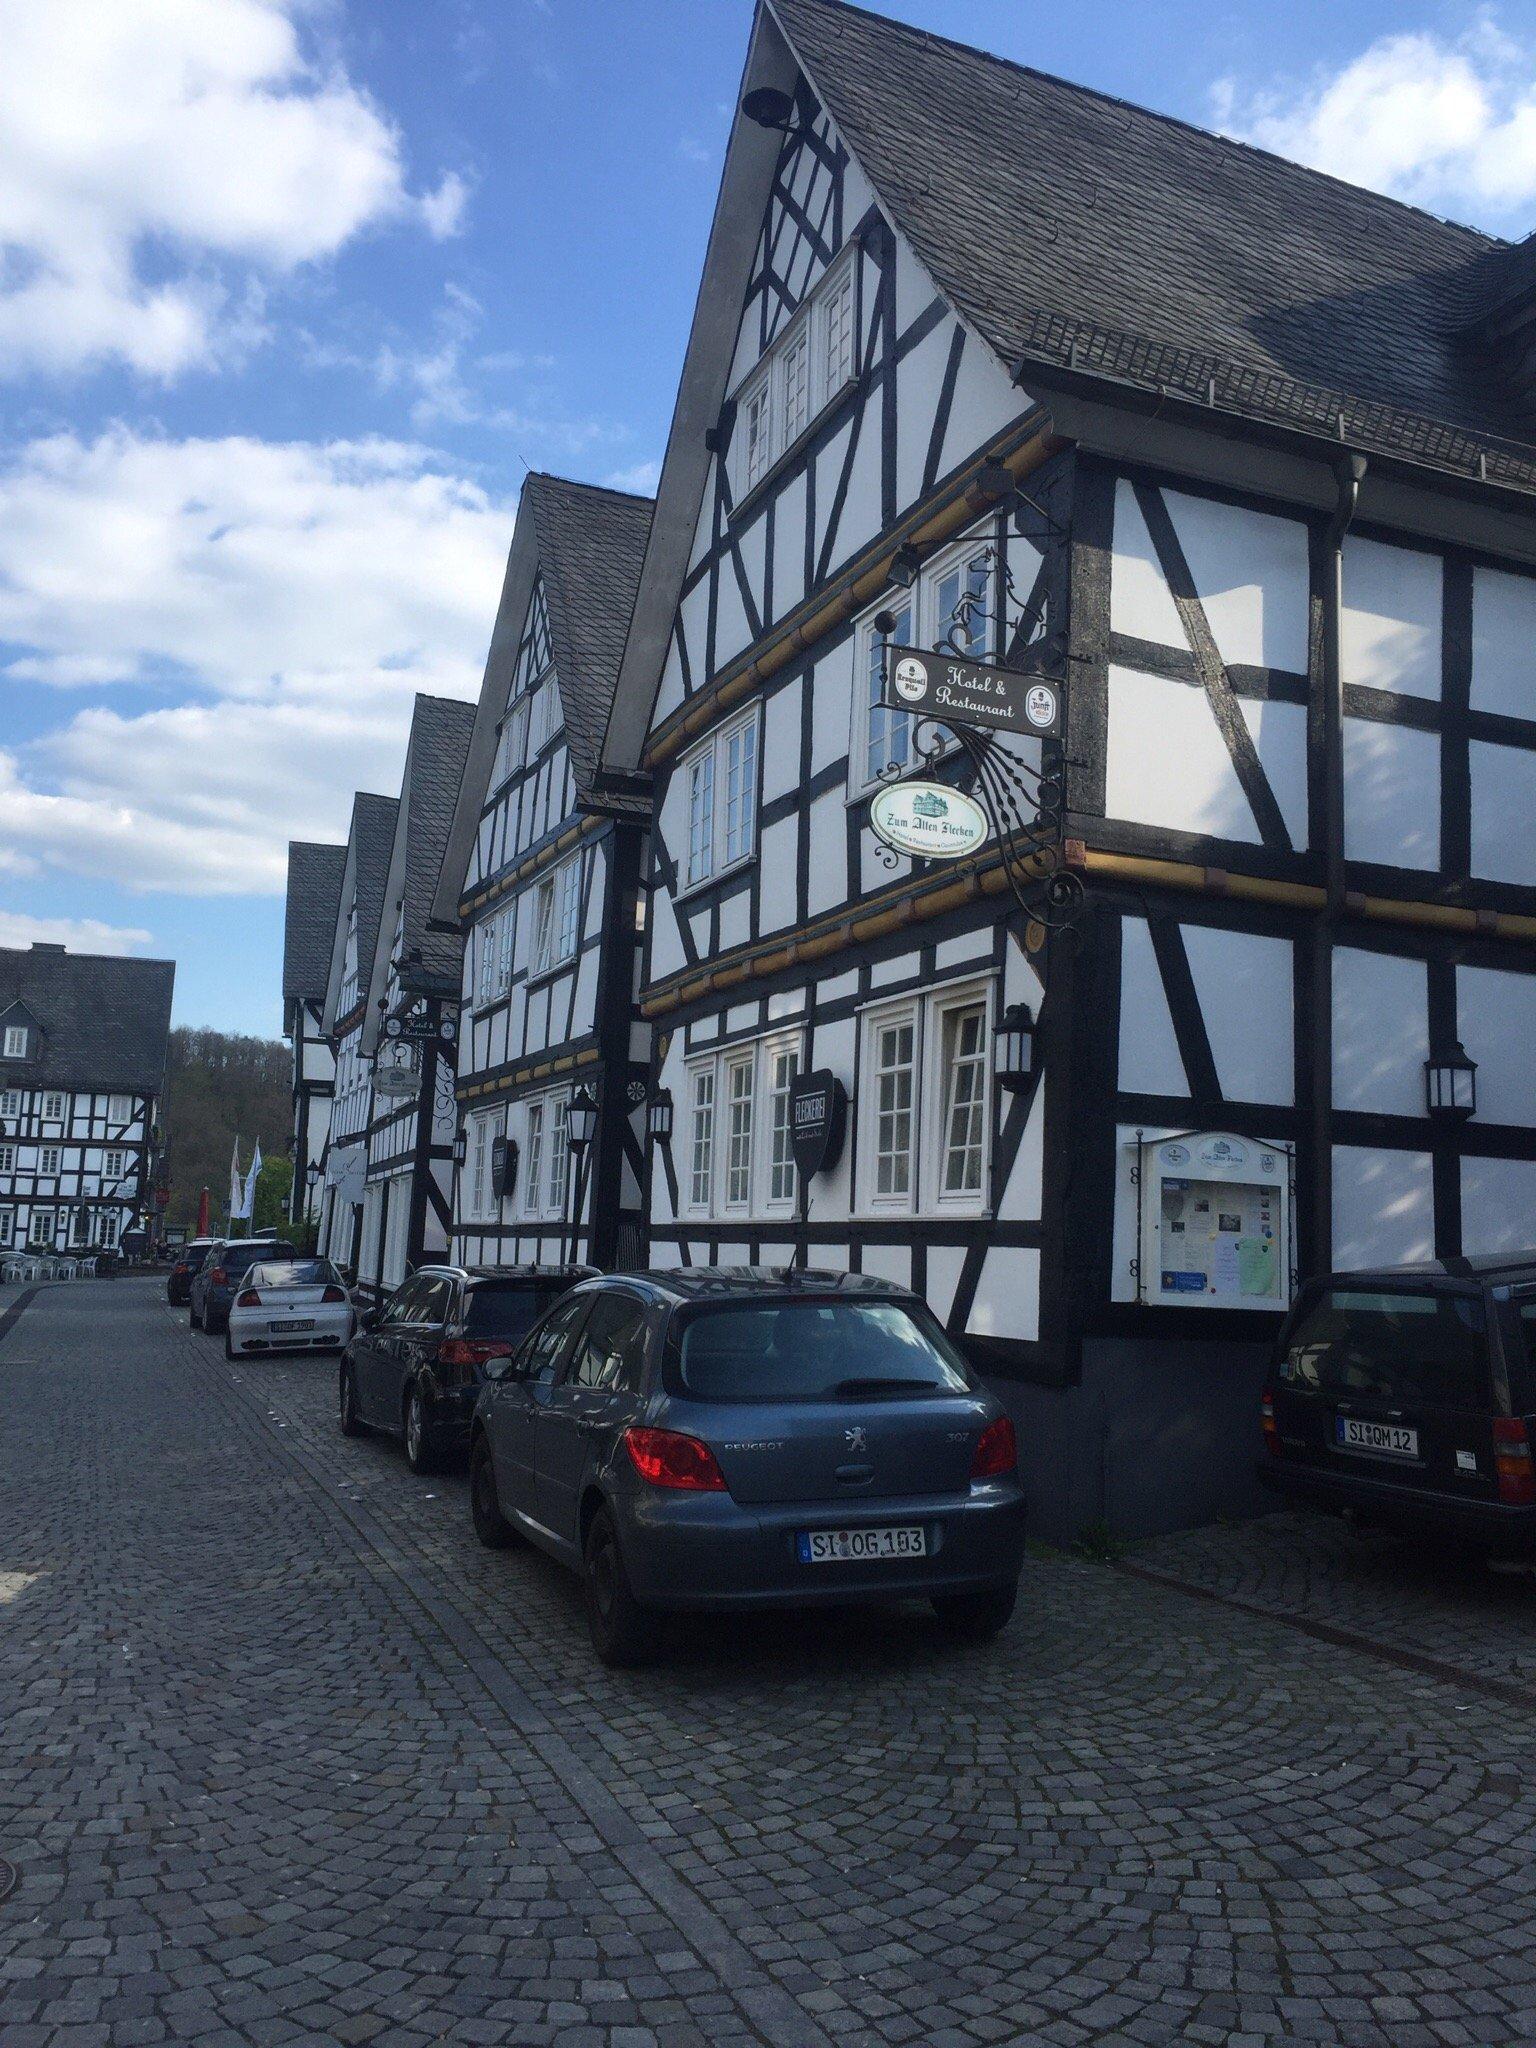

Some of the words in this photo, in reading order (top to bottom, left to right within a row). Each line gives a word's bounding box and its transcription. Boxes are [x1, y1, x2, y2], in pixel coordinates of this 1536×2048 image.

[947, 666, 992, 692] Hotel
[995, 682, 1007, 696] &
[935, 686, 1015, 718] Restaurant
[886, 813, 908, 827] Zum
[912, 817, 938, 832] Alten
[941, 821, 974, 838] Flecken
[795, 1097, 826, 1123] FLECKEREI
[724, 1441, 784, 1452] PEUGEOT
[945, 1432, 970, 1443] 307
[1349, 1422, 1365, 1443] SI
[1373, 1427, 1391, 1447] QM
[1393, 1431, 1411, 1450] 12
[813, 1534, 837, 1557] SI
[851, 1532, 879, 1555] OG
